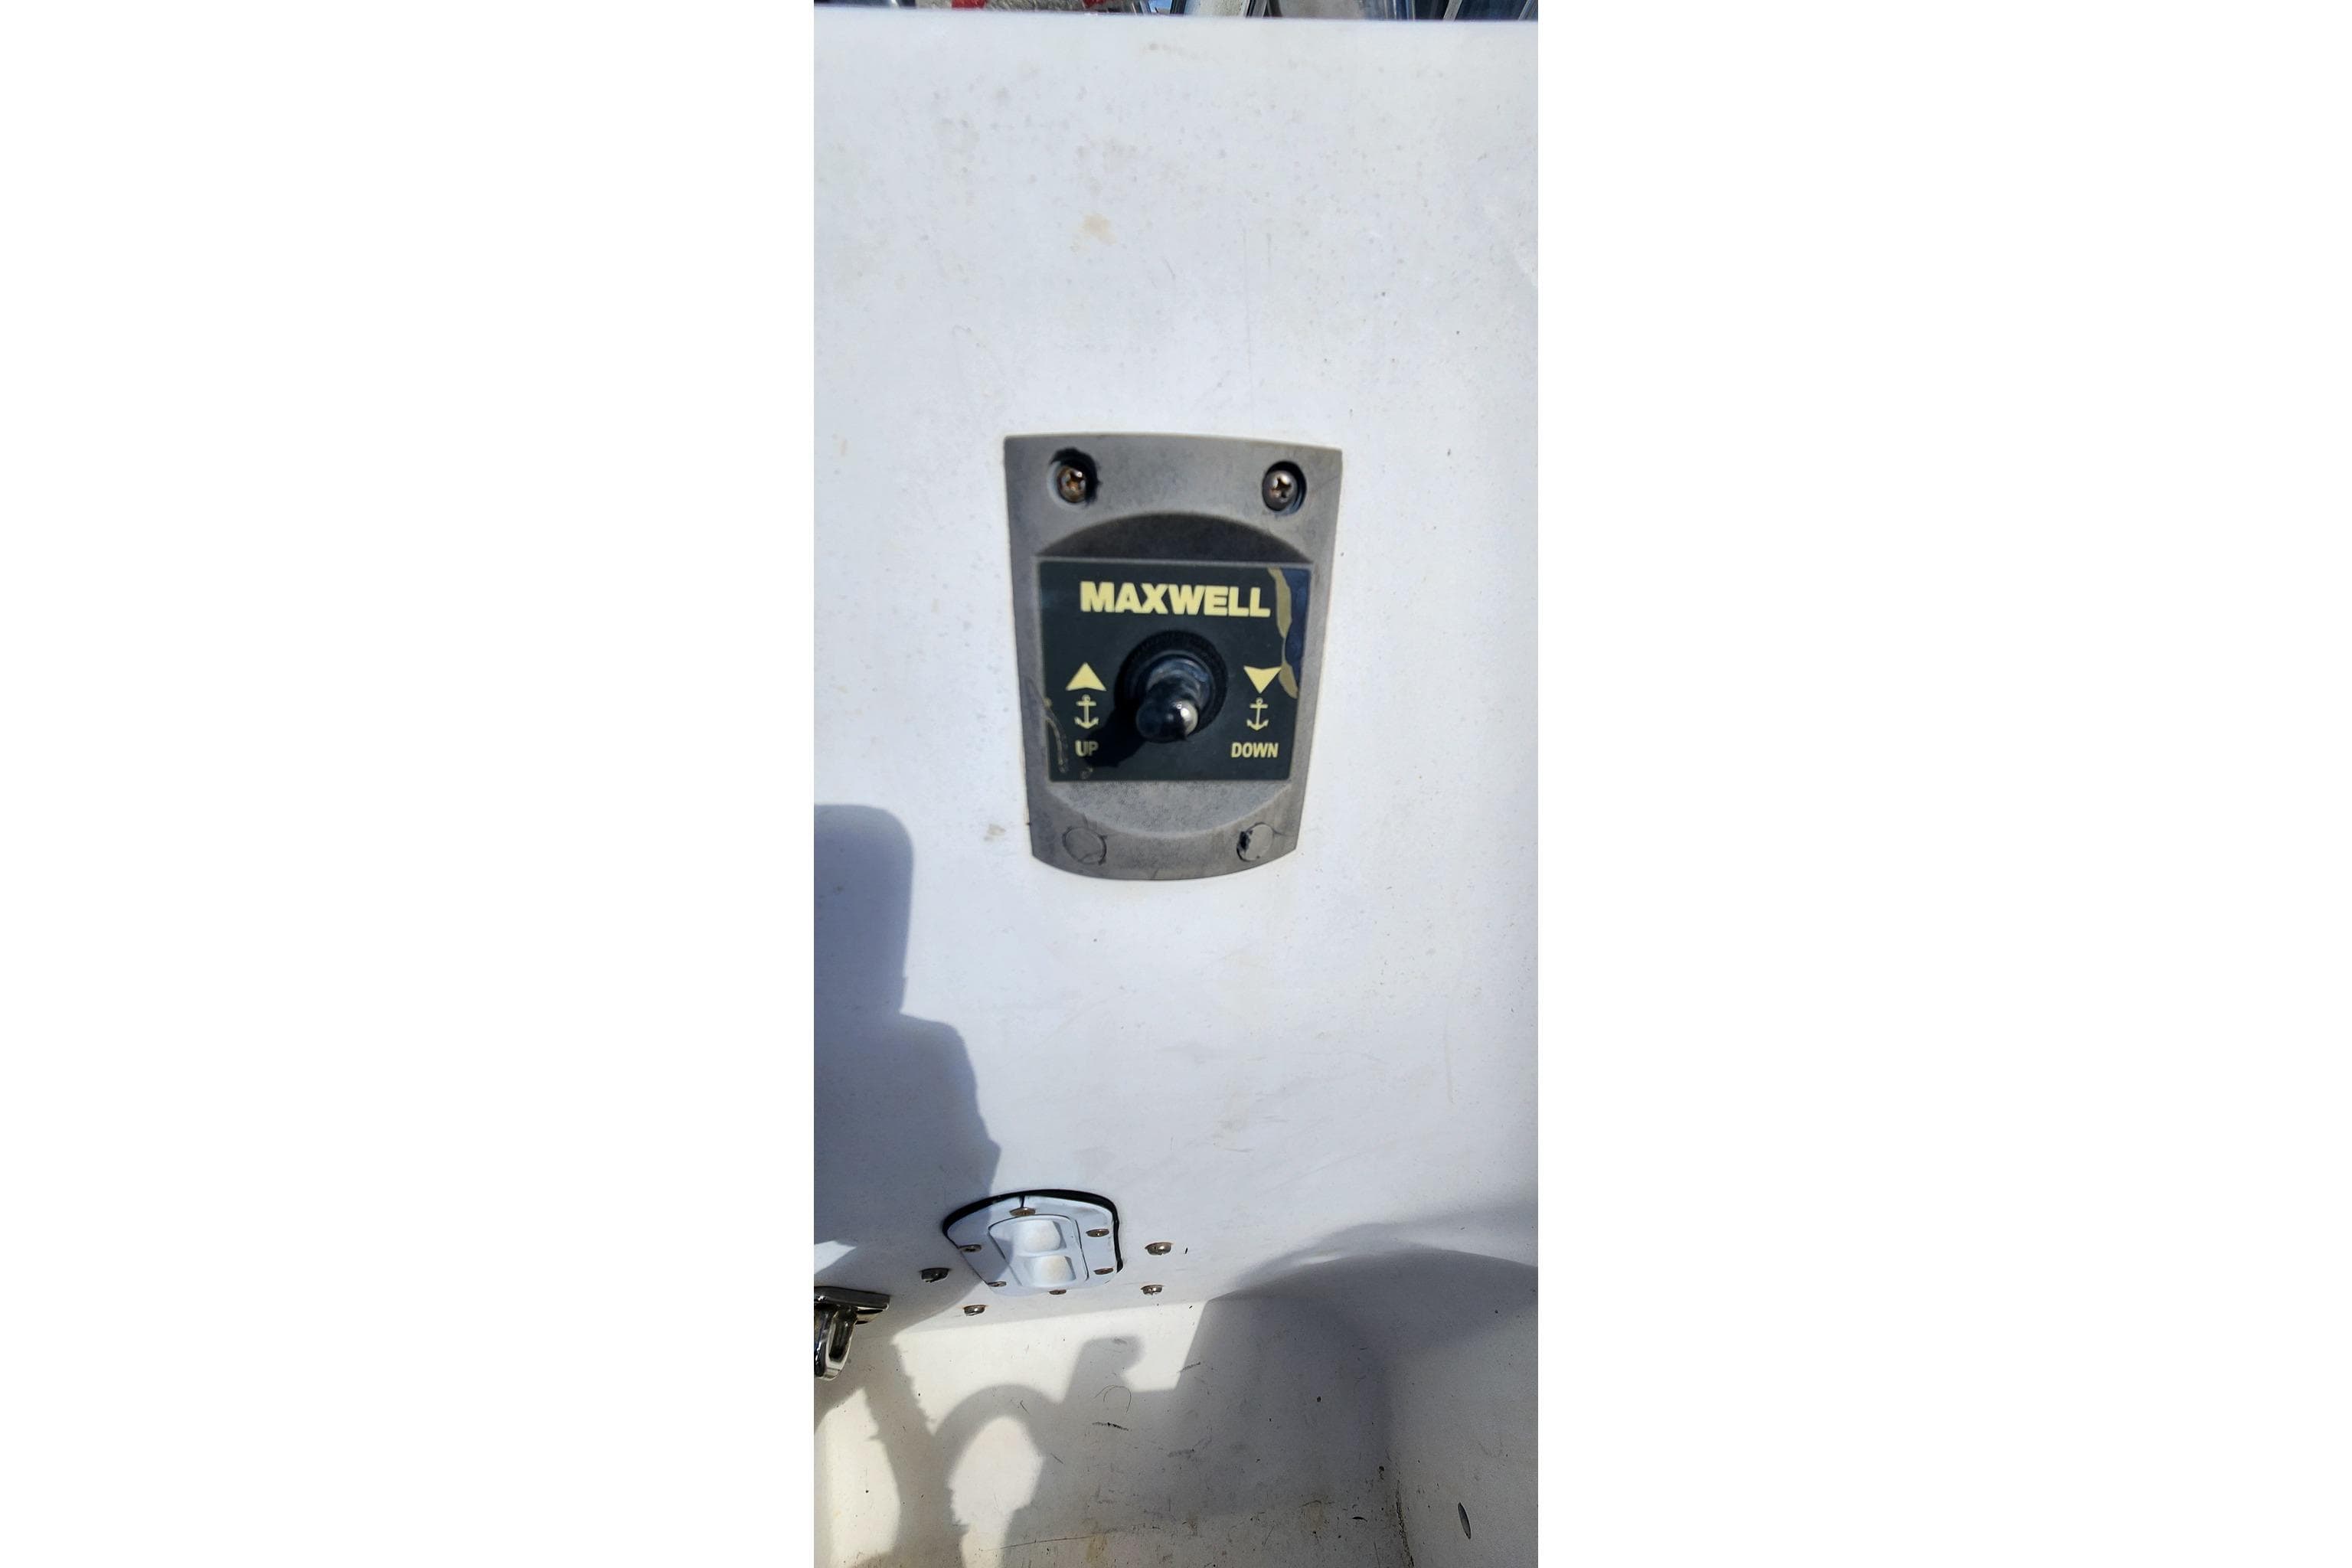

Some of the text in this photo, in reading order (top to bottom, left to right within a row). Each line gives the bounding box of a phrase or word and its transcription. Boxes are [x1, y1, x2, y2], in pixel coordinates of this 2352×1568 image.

[1080, 580, 1271, 617] MAXWELL
[1074, 740, 1099, 757] UP
[1230, 742, 1279, 758] DOWN
